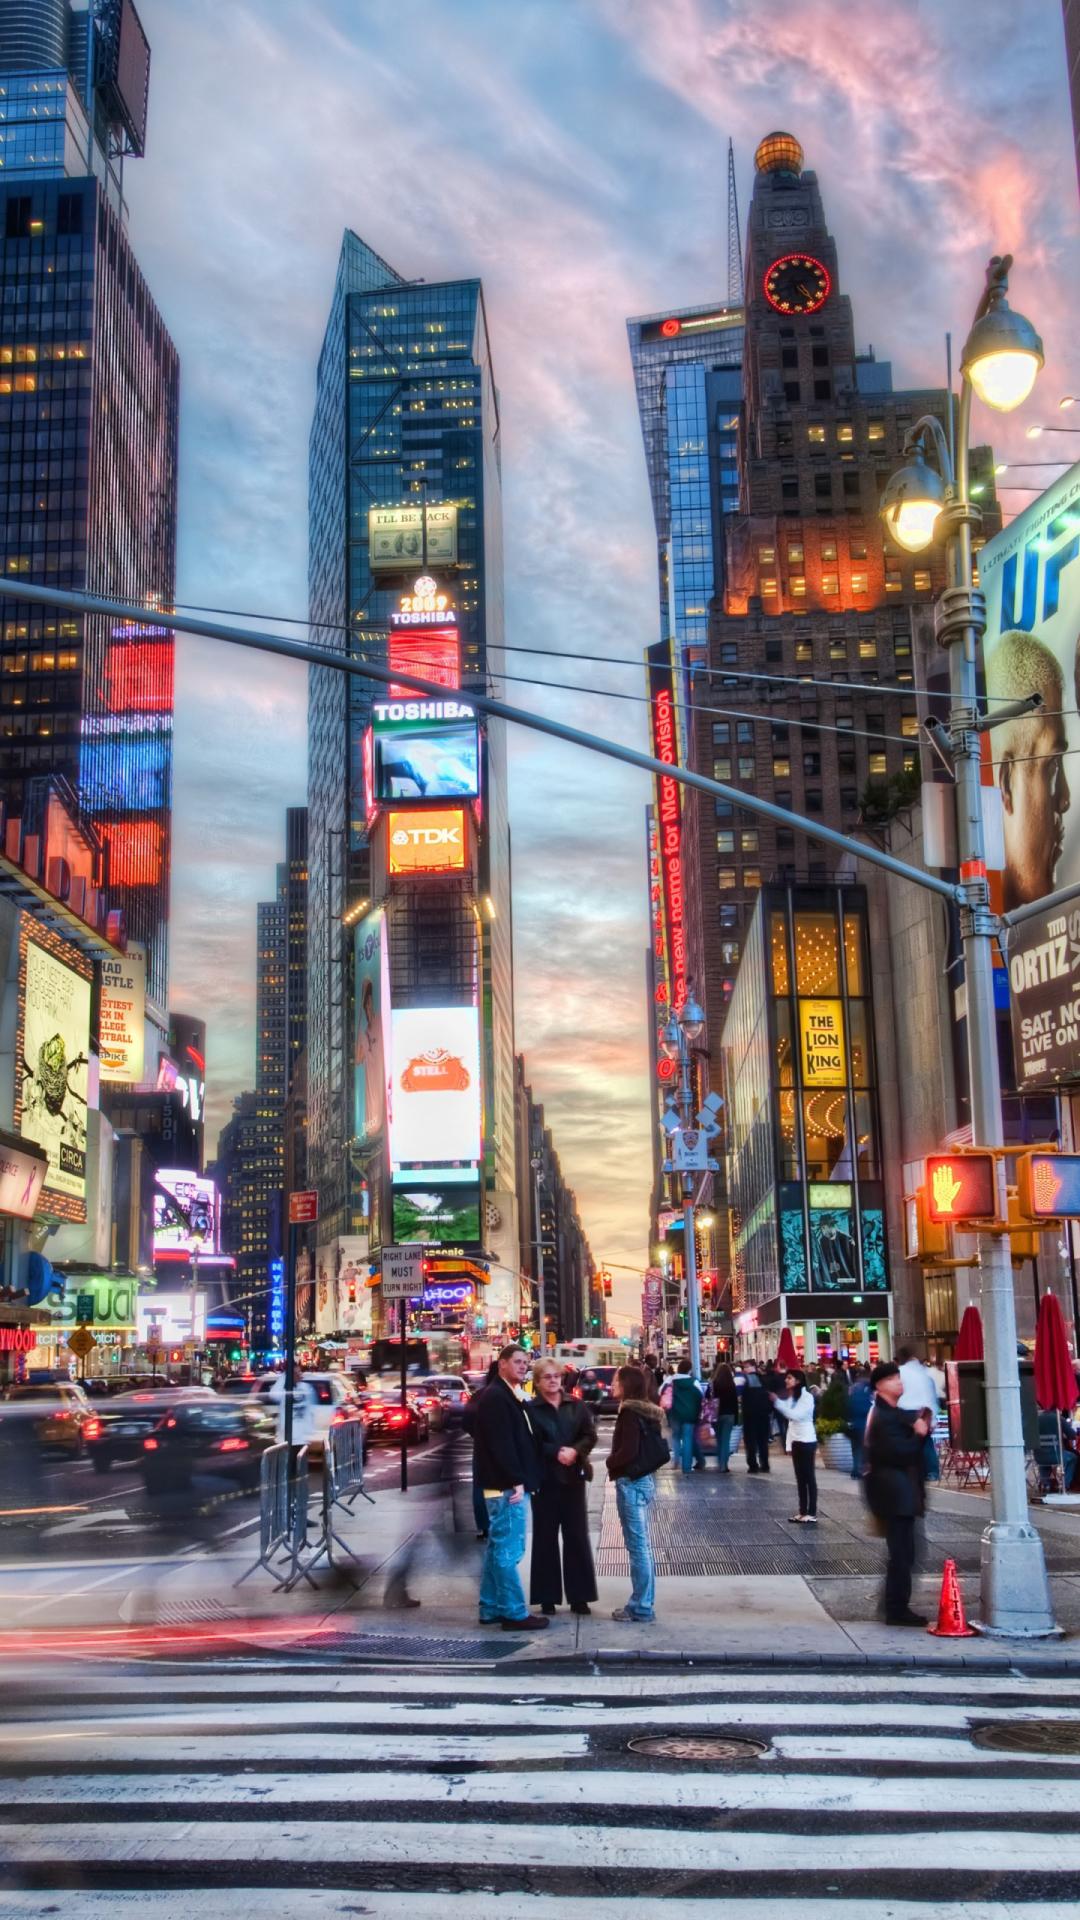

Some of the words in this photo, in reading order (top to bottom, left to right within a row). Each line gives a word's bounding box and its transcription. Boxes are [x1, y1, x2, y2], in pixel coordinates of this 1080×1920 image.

[376, 515, 398, 524] I'LL
[401, 514, 416, 523] BE
[420, 512, 450, 522] ACK
[1025, 494, 1068, 537] FIGHTING
[401, 596, 448, 612] 2009
[391, 611, 456, 625] TOSHIBA
[373, 701, 475, 721] TOSHIBA
[656, 689, 678, 822] Macovision
[411, 828, 460, 844] TDK
[664, 825, 679, 856] for
[668, 857, 682, 922] name
[1047, 915, 1067, 939] TITO
[672, 927, 686, 974] new
[101, 962, 122, 975] HAD
[1011, 934, 1071, 995] ORTIZ
[101, 977, 133, 990] STLE
[101, 1000, 133, 1011] STIEST
[114, 1011, 124, 1021] IN
[809, 1016, 834, 1028] THE
[99, 1021, 126, 1032] LLEGE
[1020, 1010, 1056, 1040] SAT.
[99, 1033, 133, 1044] OTBALL
[806, 1031, 839, 1051] LION
[1022, 1034, 1052, 1058] LIVE
[1056, 1024, 1079, 1046] ON
[807, 1054, 841, 1075] KING
[61, 1147, 83, 1169] CIRCA
[384, 1252, 403, 1262] RIGHT
[404, 1250, 421, 1261] LANE
[391, 1266, 413, 1277] MUST
[384, 1283, 400, 1292] TURN
[403, 1282, 422, 1292] RIGHT
